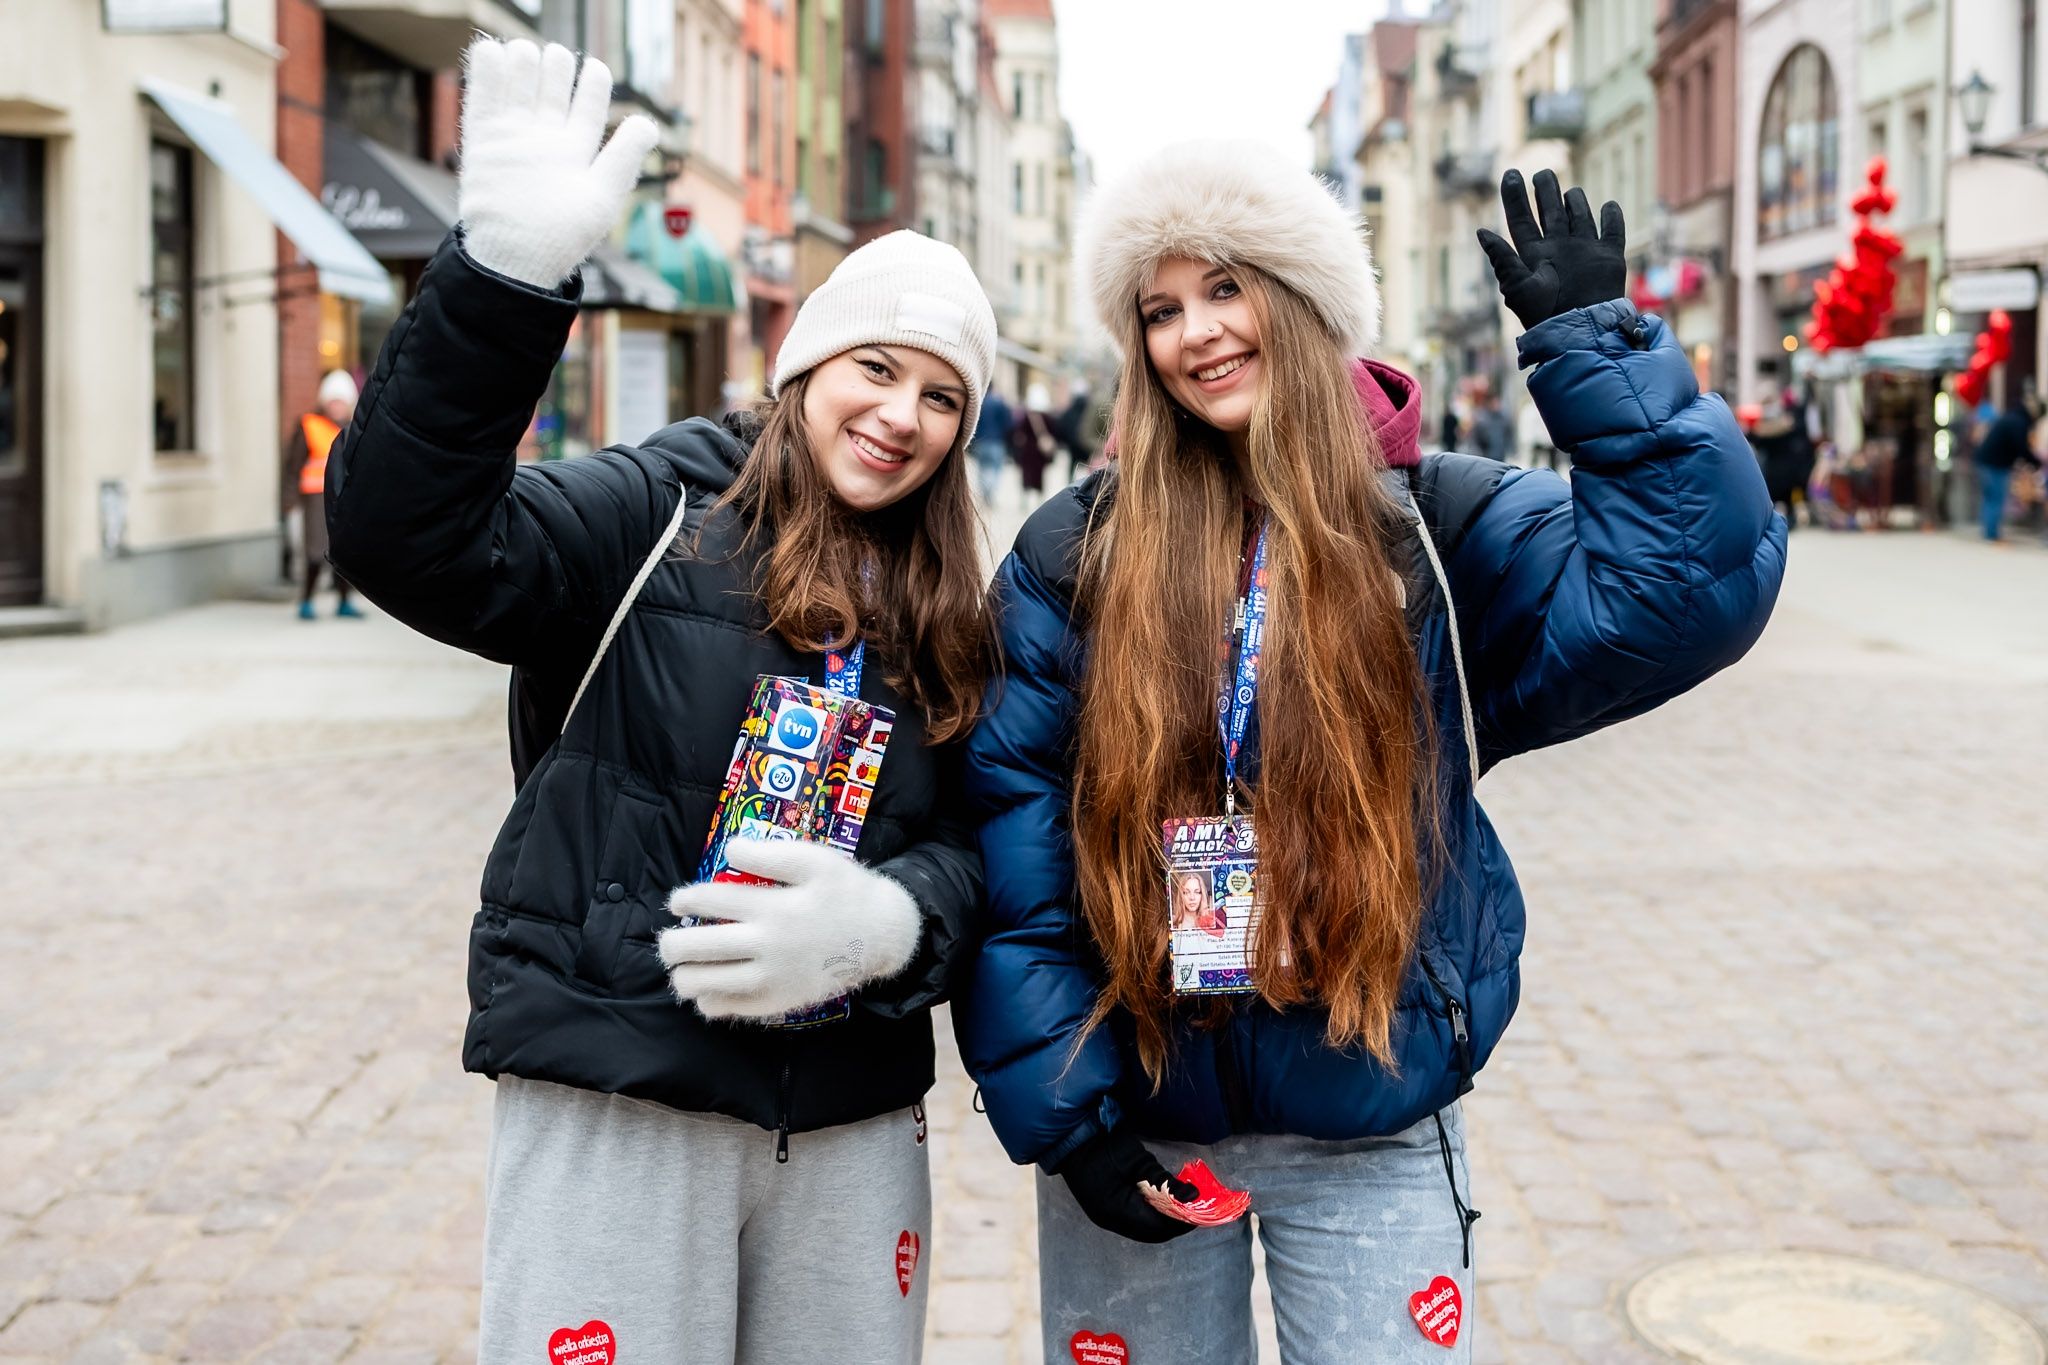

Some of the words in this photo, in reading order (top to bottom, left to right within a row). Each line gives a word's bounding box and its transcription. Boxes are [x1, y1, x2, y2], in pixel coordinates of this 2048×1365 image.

[783, 717, 812, 739] tvn
[1174, 825, 1189, 842] A
[1415, 1300, 1433, 1322] wielka
[1430, 1286, 1455, 1309] orkiestra
[553, 1337, 578, 1356] wielka
[577, 1331, 610, 1350] orkiestra
[1075, 1338, 1098, 1351] wielka
[1097, 1341, 1125, 1356] orkiestra
